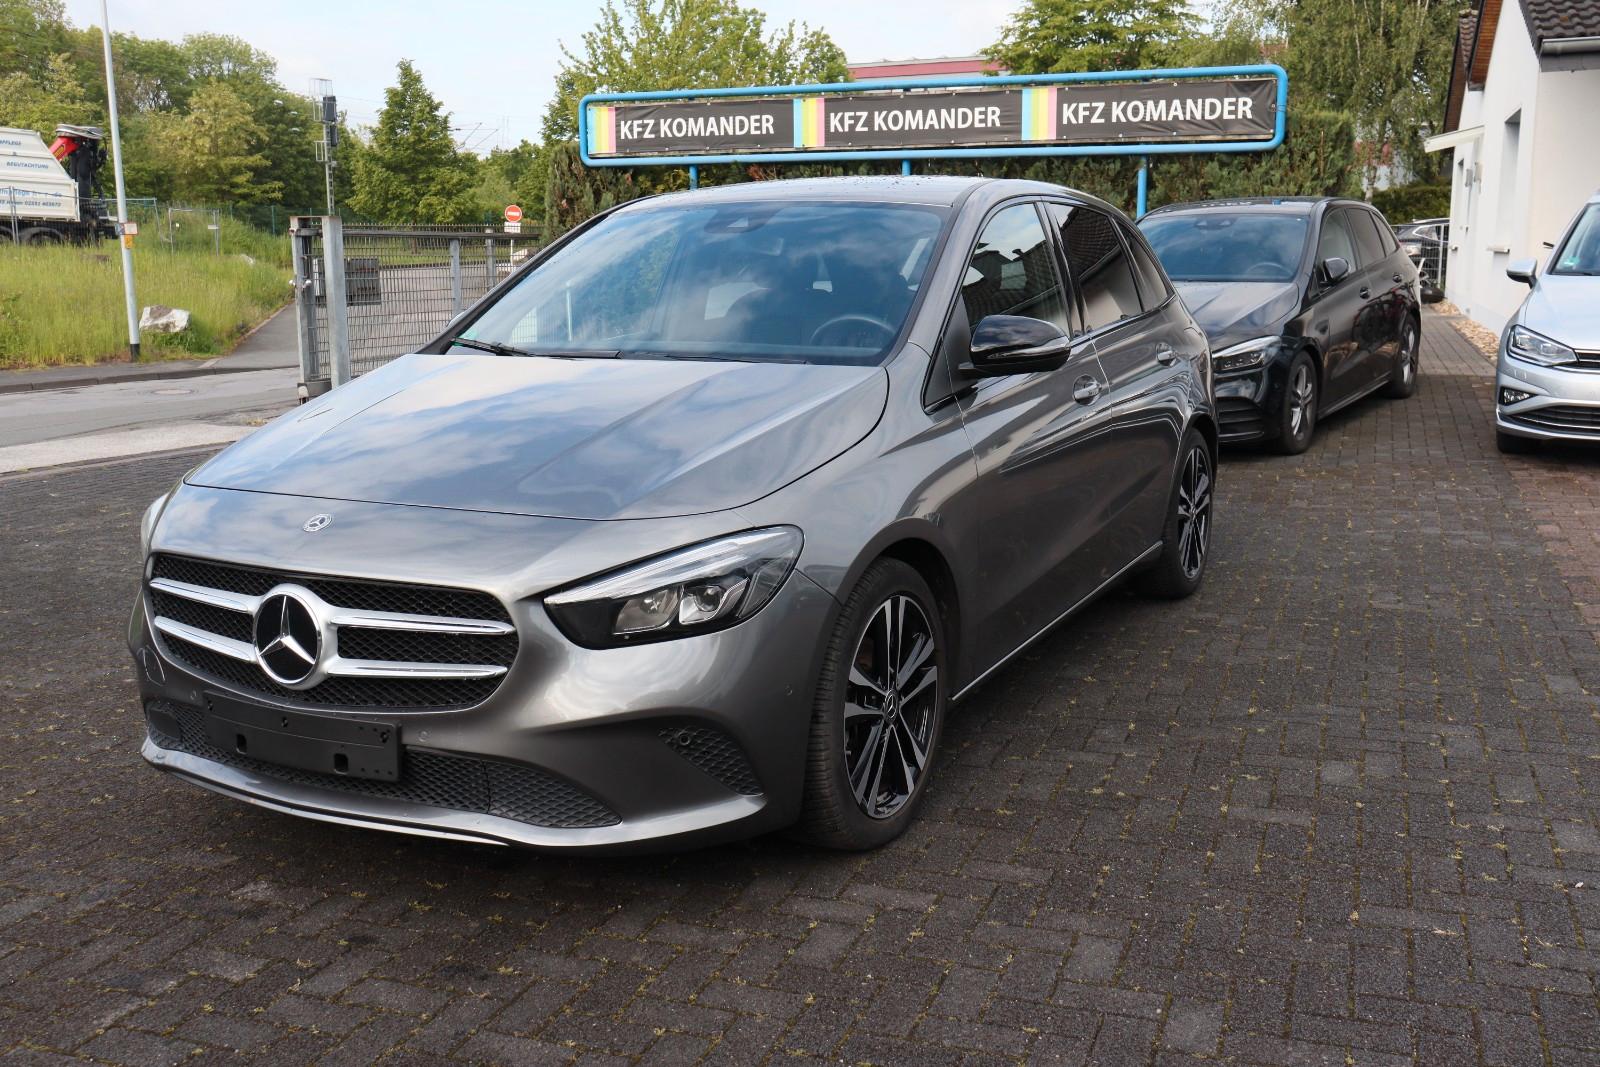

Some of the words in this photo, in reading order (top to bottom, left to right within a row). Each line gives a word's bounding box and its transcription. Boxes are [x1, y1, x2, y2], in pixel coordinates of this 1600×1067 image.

[830, 111, 868, 132] KFZ
[874, 106, 1001, 131] KOMANDER
[1063, 102, 1105, 124] KFZ
[1112, 97, 1252, 122] KOMANDER
[620, 118, 655, 139] KFZ
[660, 115, 774, 138] KOMANDER
